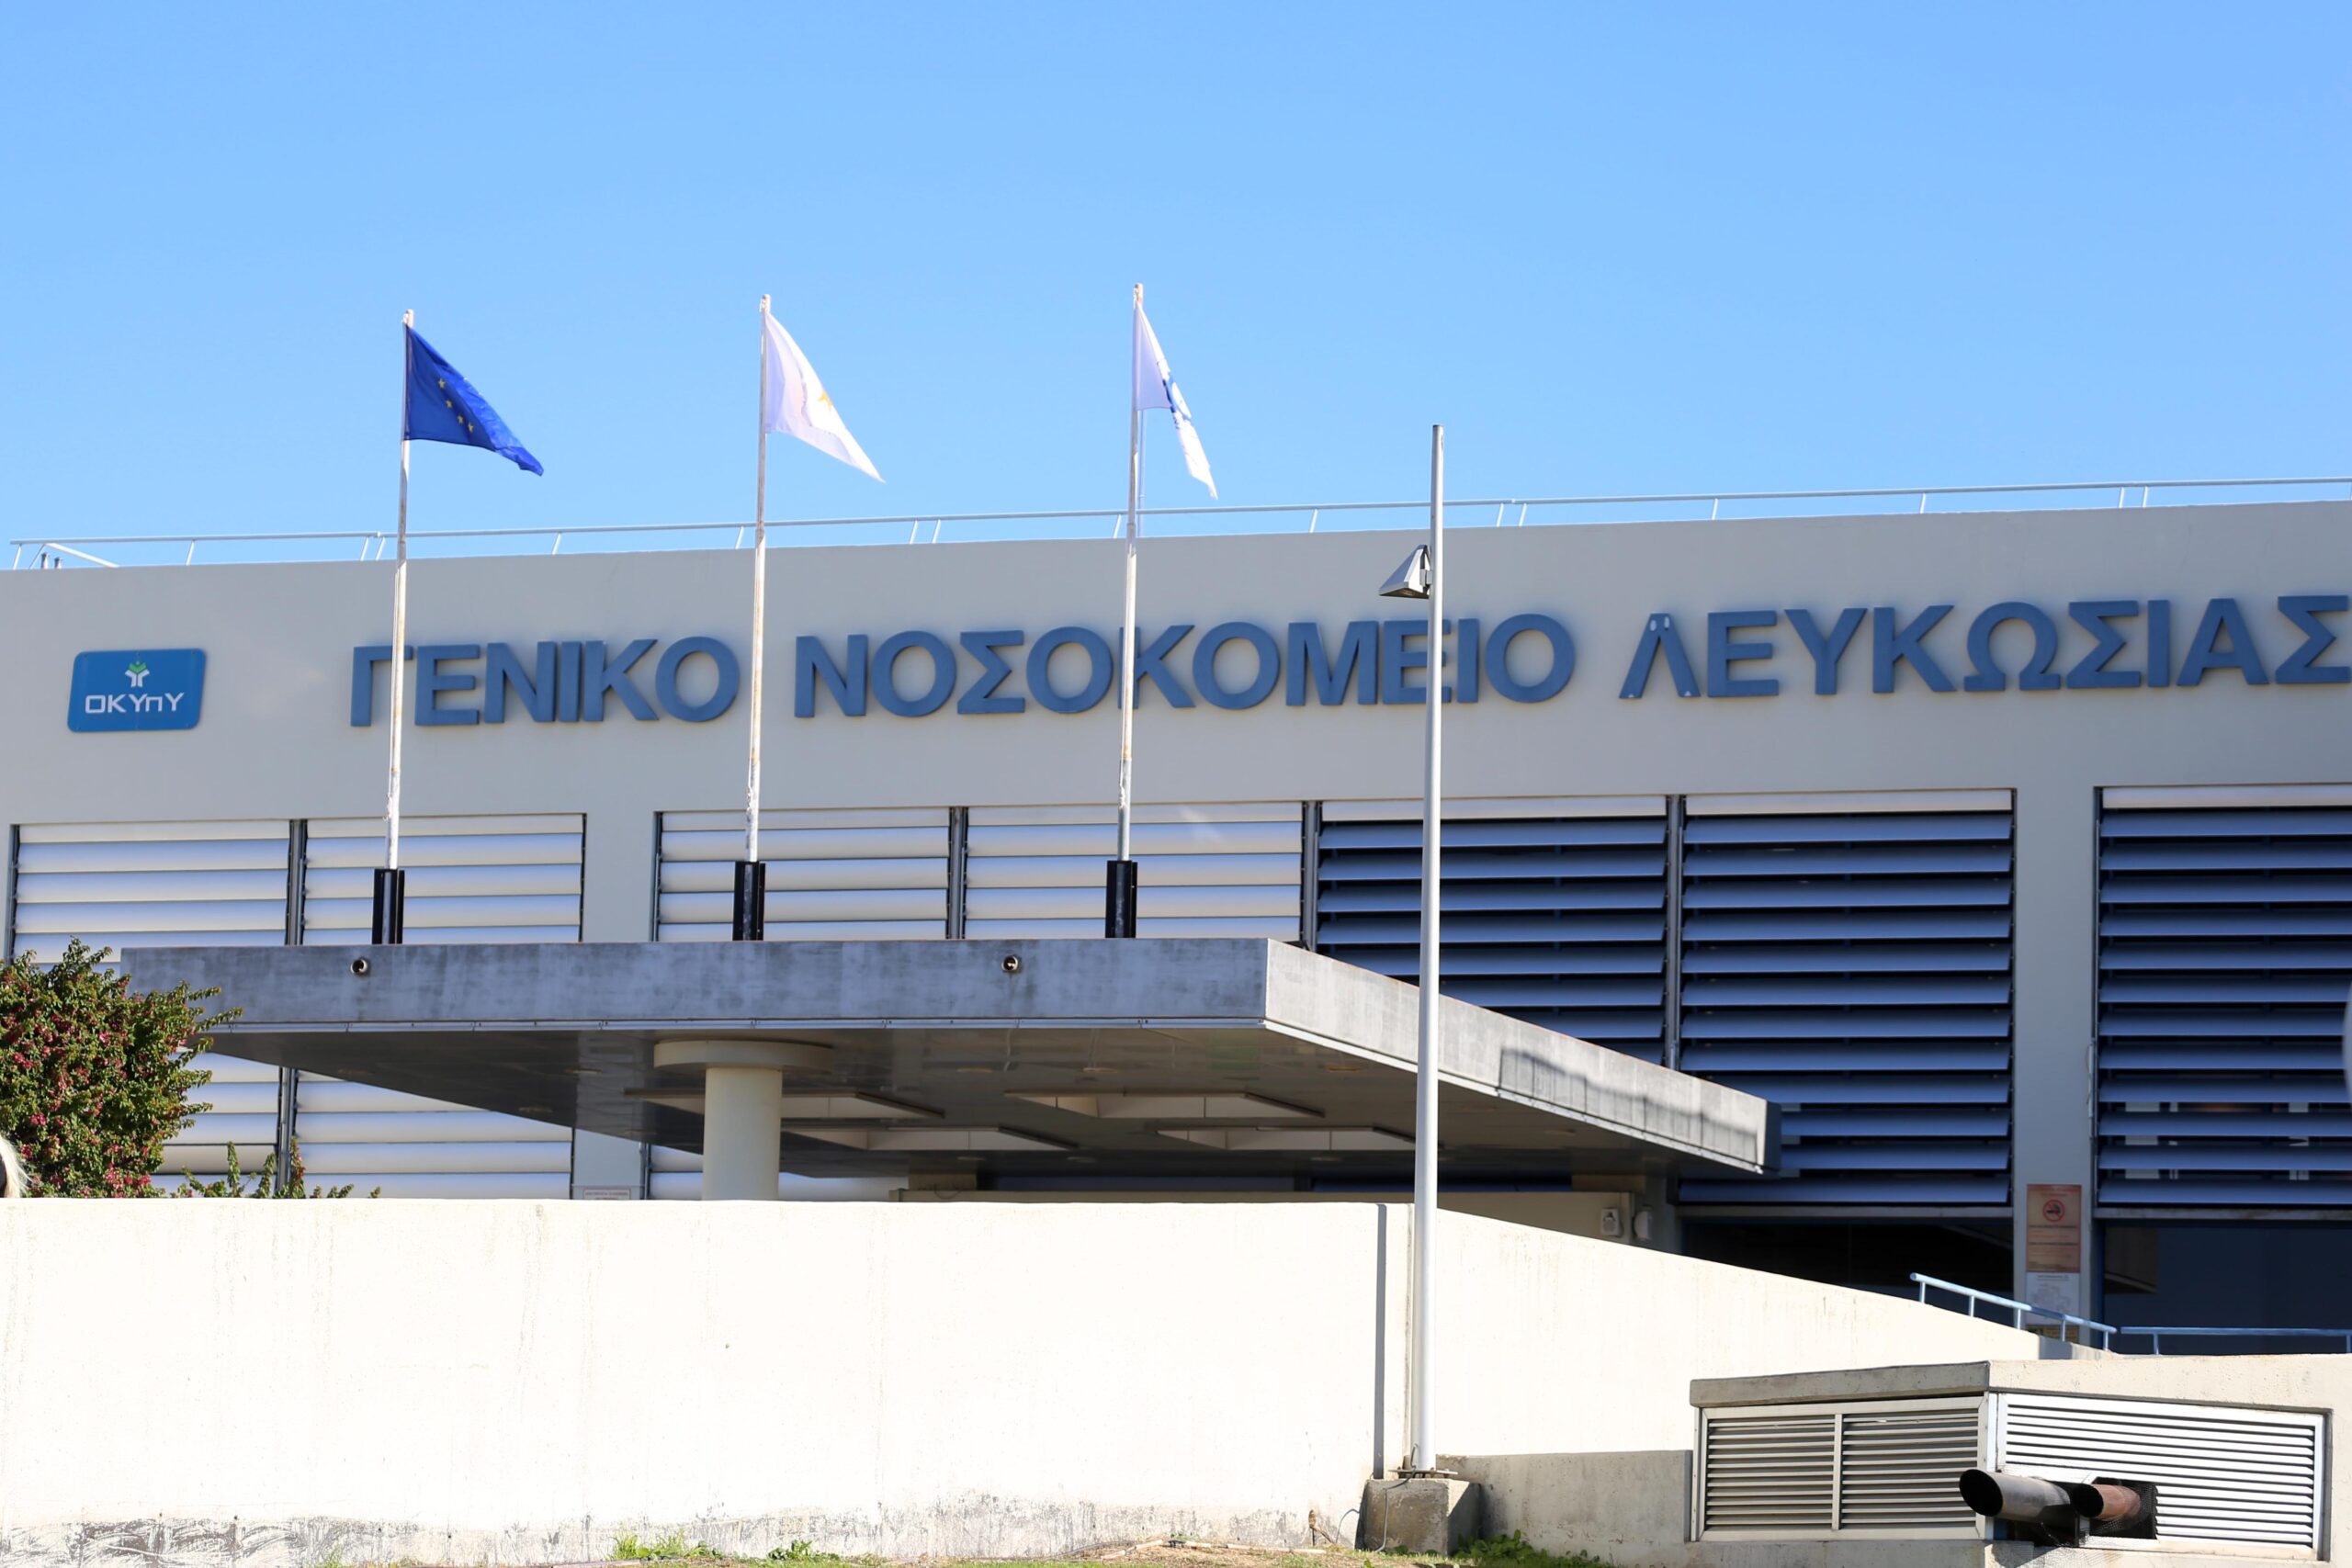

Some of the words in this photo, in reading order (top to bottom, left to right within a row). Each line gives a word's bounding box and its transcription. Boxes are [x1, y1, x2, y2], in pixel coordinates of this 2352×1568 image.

[350, 636, 741, 727] ΓΕΝΙΚΟ
[794, 613, 1576, 717] ΝΟΣΟΚΟΜΕΙΟ
[1619, 594, 2350, 698] ΛΕΥΚΩΣΙΑΣ
